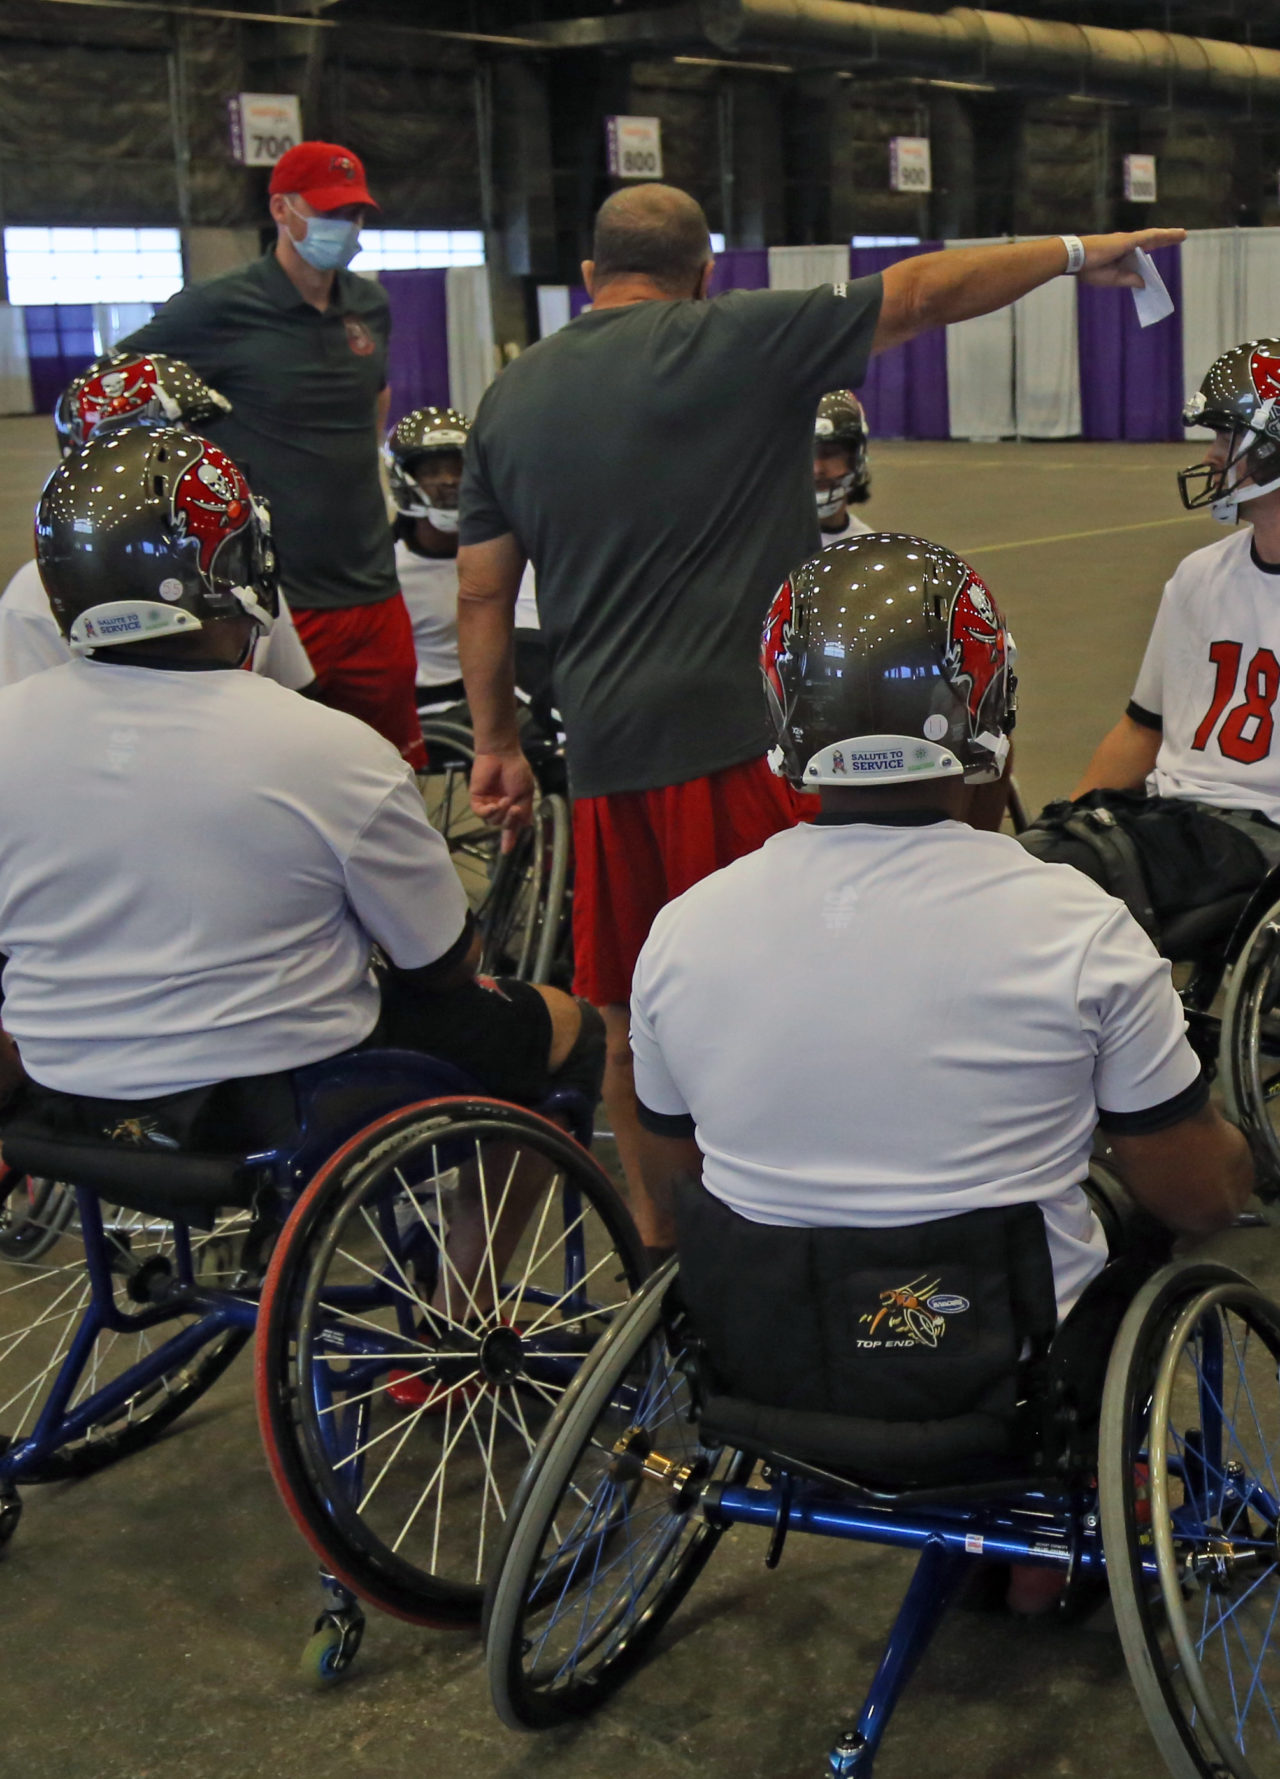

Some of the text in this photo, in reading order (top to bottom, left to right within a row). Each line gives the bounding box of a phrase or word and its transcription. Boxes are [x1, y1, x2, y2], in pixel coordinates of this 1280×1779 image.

[251, 134, 294, 159] 700
[624, 150, 656, 172] 800
[97, 614, 139, 626] SALUTE TO
[100, 621, 142, 634] SERVICE
[851, 749, 904, 761] SALUTE TO
[852, 759, 904, 771] SERVICE
[856, 1340, 915, 1349] TOP END
